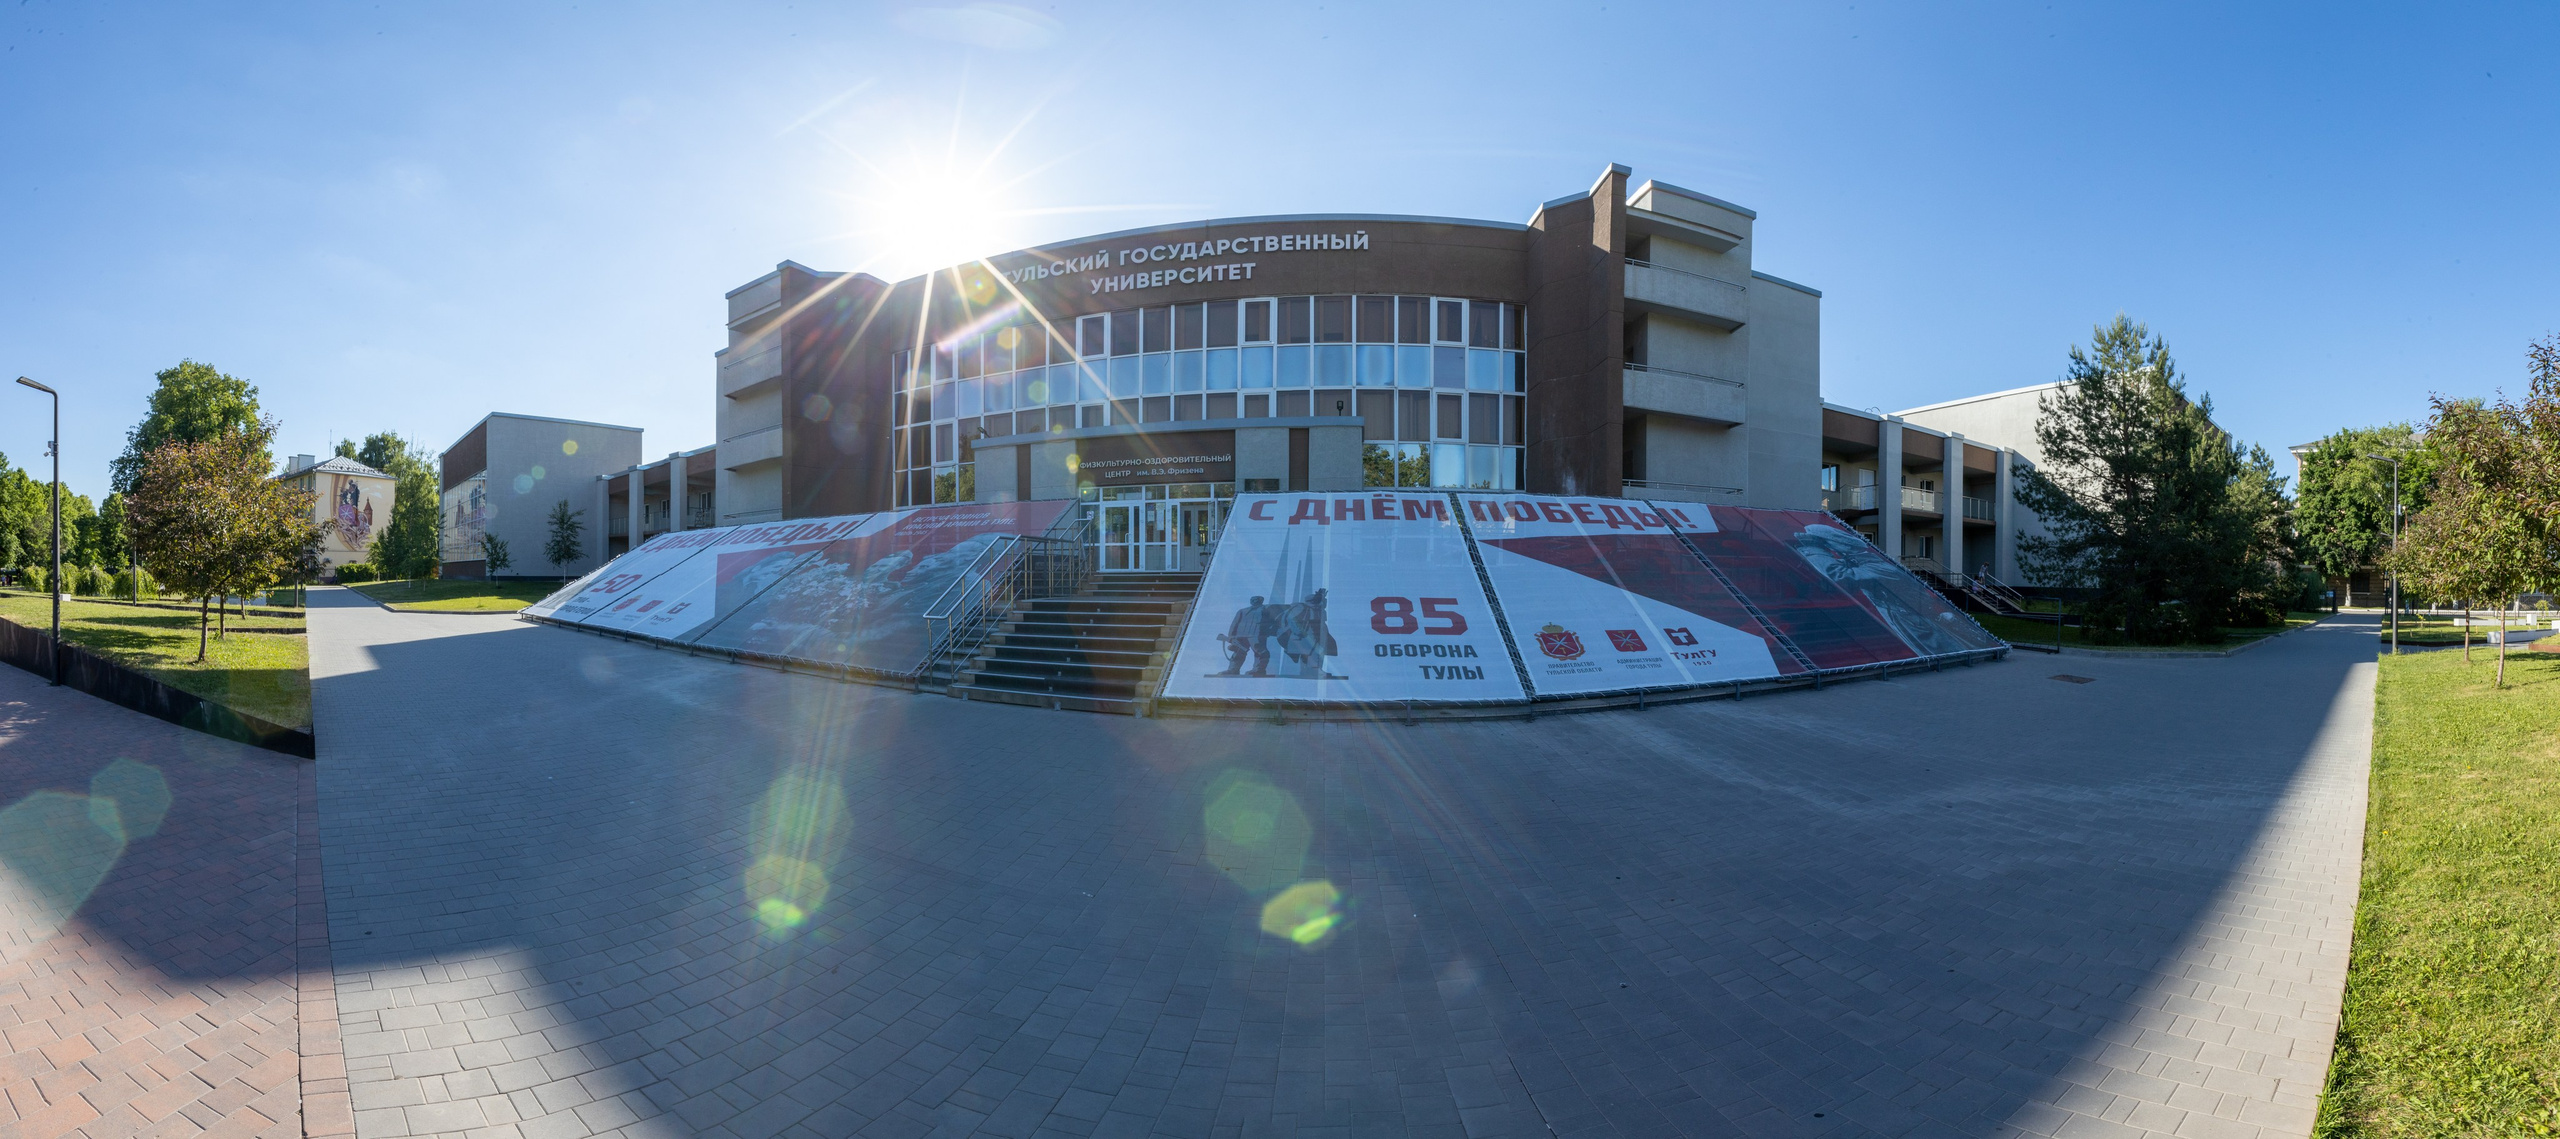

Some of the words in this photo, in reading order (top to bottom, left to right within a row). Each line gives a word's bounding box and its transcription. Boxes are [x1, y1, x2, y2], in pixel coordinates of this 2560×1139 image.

[1002, 250, 1109, 284] ТУЛЬСКИЙ
[1119, 230, 1369, 266] ГОСУДАРСТВЕННЫЙ
[1090, 263, 1256, 295] УНИВЕРСИТЕТ
[1079, 454, 1231, 469] ФИЗКУЛЬТУРНО-ОЗДОРОВИТЕЛЬНЫЙ
[1105, 470, 1131, 479] ЦЕНТР
[1167, 467, 1204, 476] Фризена
[1248, 500, 1278, 521] С
[1288, 494, 1449, 525] ДНЁМ
[1468, 500, 1698, 531] ПОБЕДЫ!
[645, 528, 727, 554] ДНЁМ
[713, 520, 861, 546] ПОБЕДЫ!
[590, 574, 643, 594] 50
[1370, 596, 1468, 635] 85
[1374, 643, 1479, 658] ОБОРОНА
[1547, 661, 1595, 669] ПРАВИТЕЛЬСТВО
[1616, 657, 1663, 665] АДМИНИСТРАЦИЯ
[1419, 665, 1485, 680] ТУЛЫ
